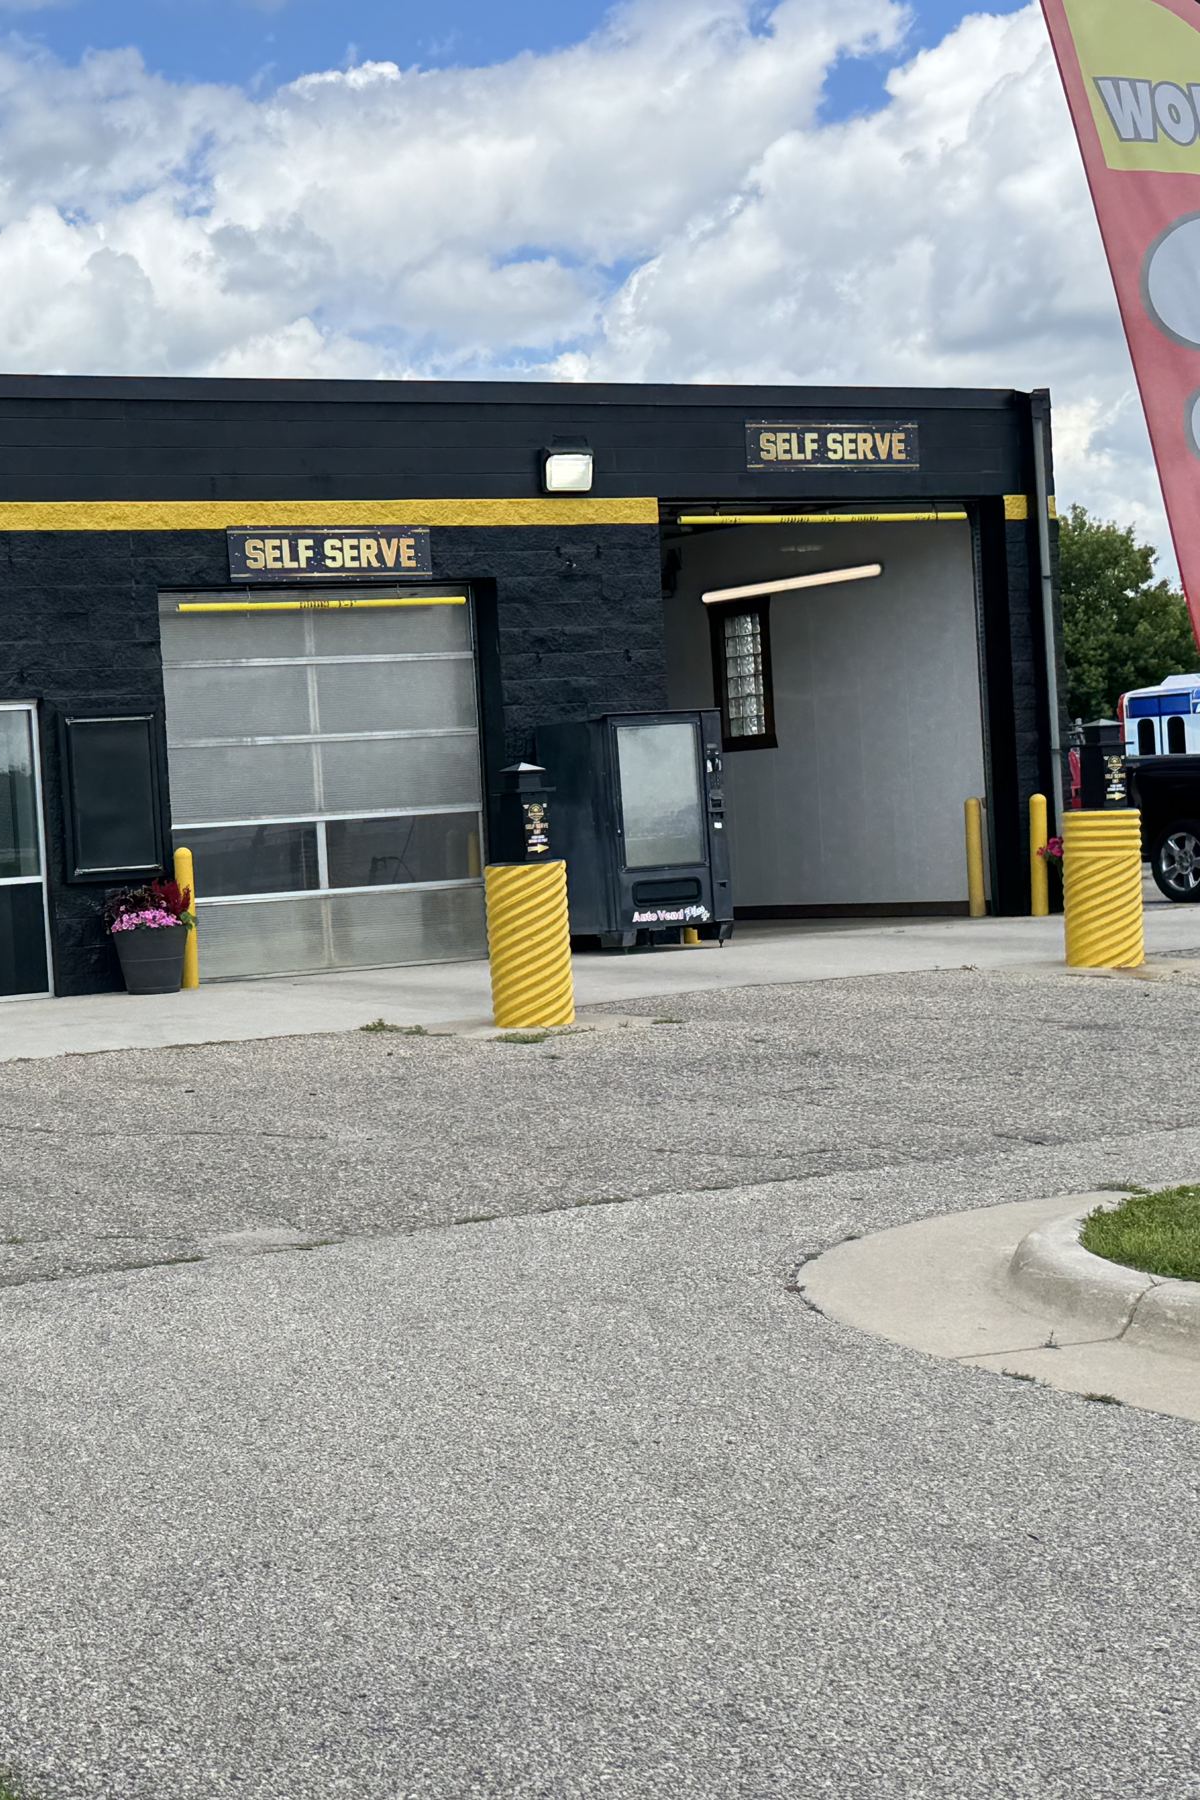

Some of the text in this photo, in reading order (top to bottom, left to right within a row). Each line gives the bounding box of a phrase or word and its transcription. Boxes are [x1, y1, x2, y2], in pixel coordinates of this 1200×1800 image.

[759, 432, 906, 461] SELF SERVE
[244, 537, 417, 570] SELF SERVE
[632, 911, 658, 922] Auto
[657, 909, 684, 921] Vend
